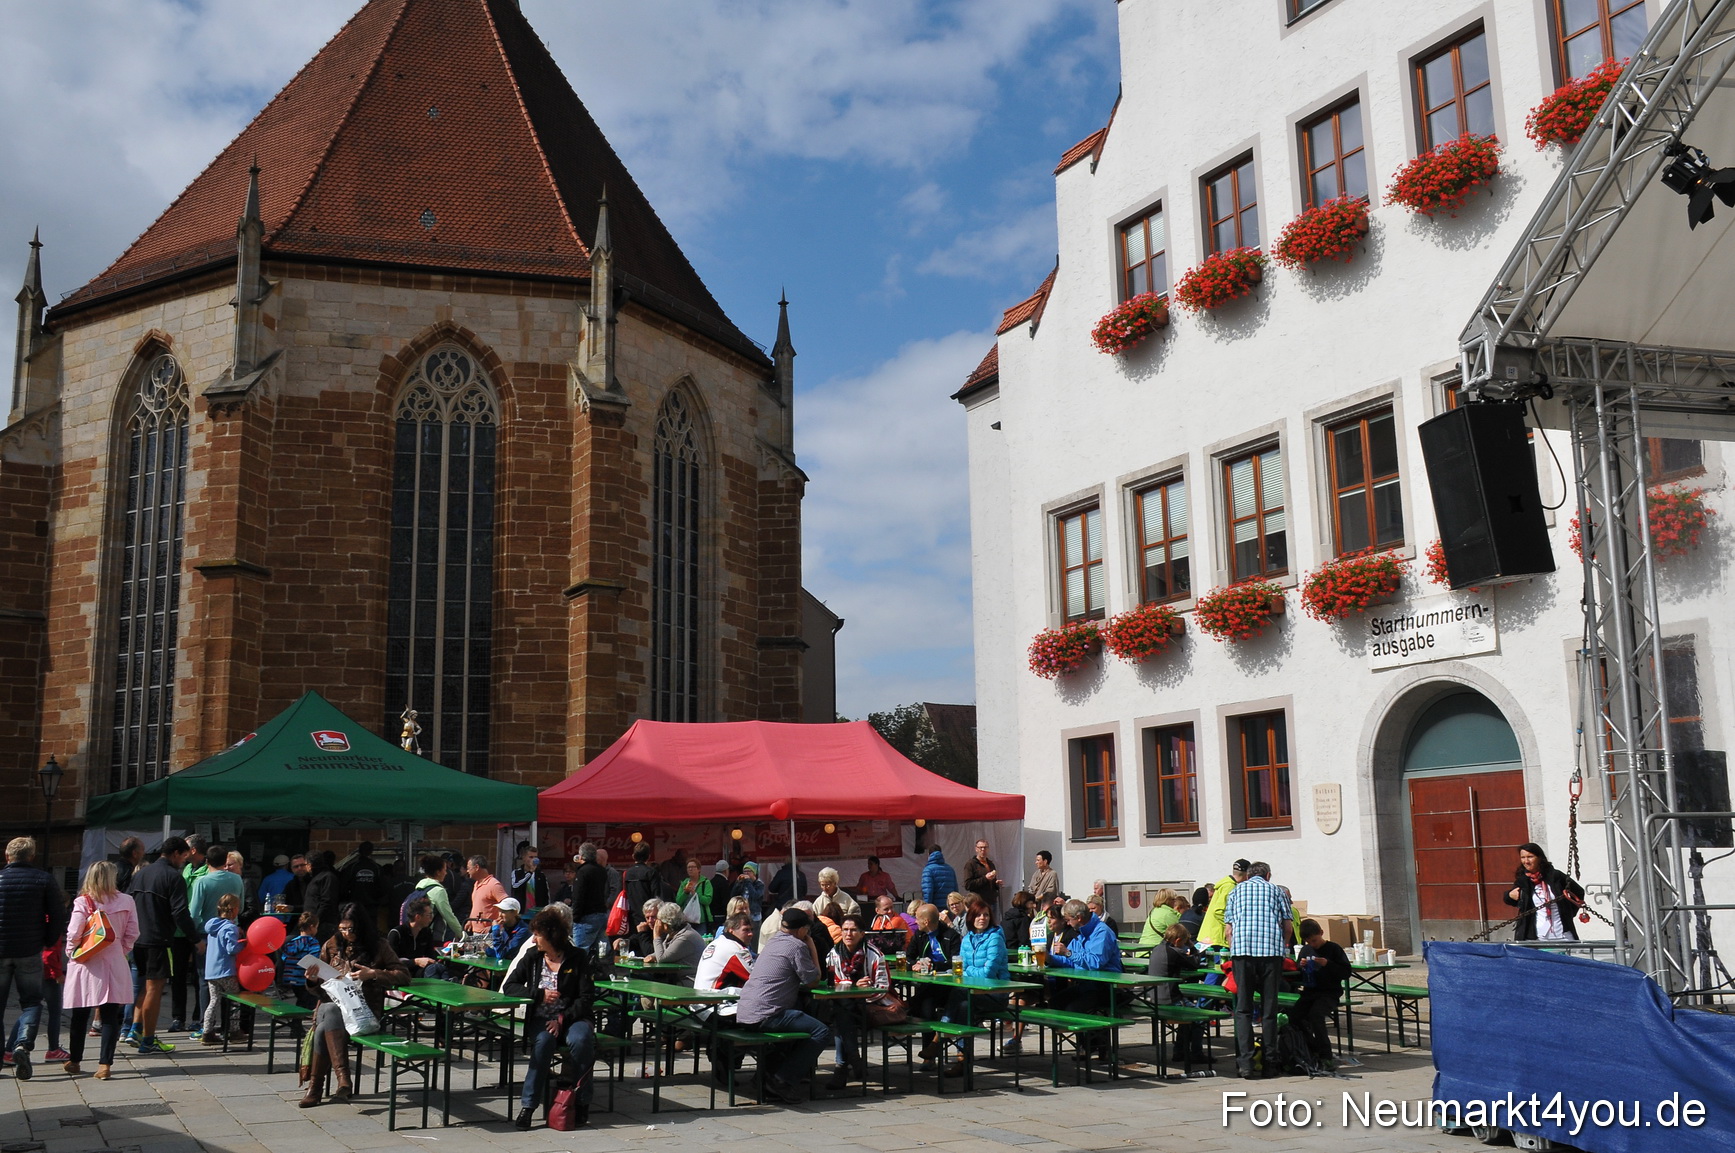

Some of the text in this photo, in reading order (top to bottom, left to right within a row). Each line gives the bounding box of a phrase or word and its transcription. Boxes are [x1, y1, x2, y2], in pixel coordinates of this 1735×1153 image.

[1371, 603, 1489, 637] Startnummern-
[1372, 632, 1435, 657] ausgabe
[297, 754, 384, 763] Neumarkter
[284, 761, 406, 772] Lammsbräu
[1031, 928, 1045, 938] 2373
